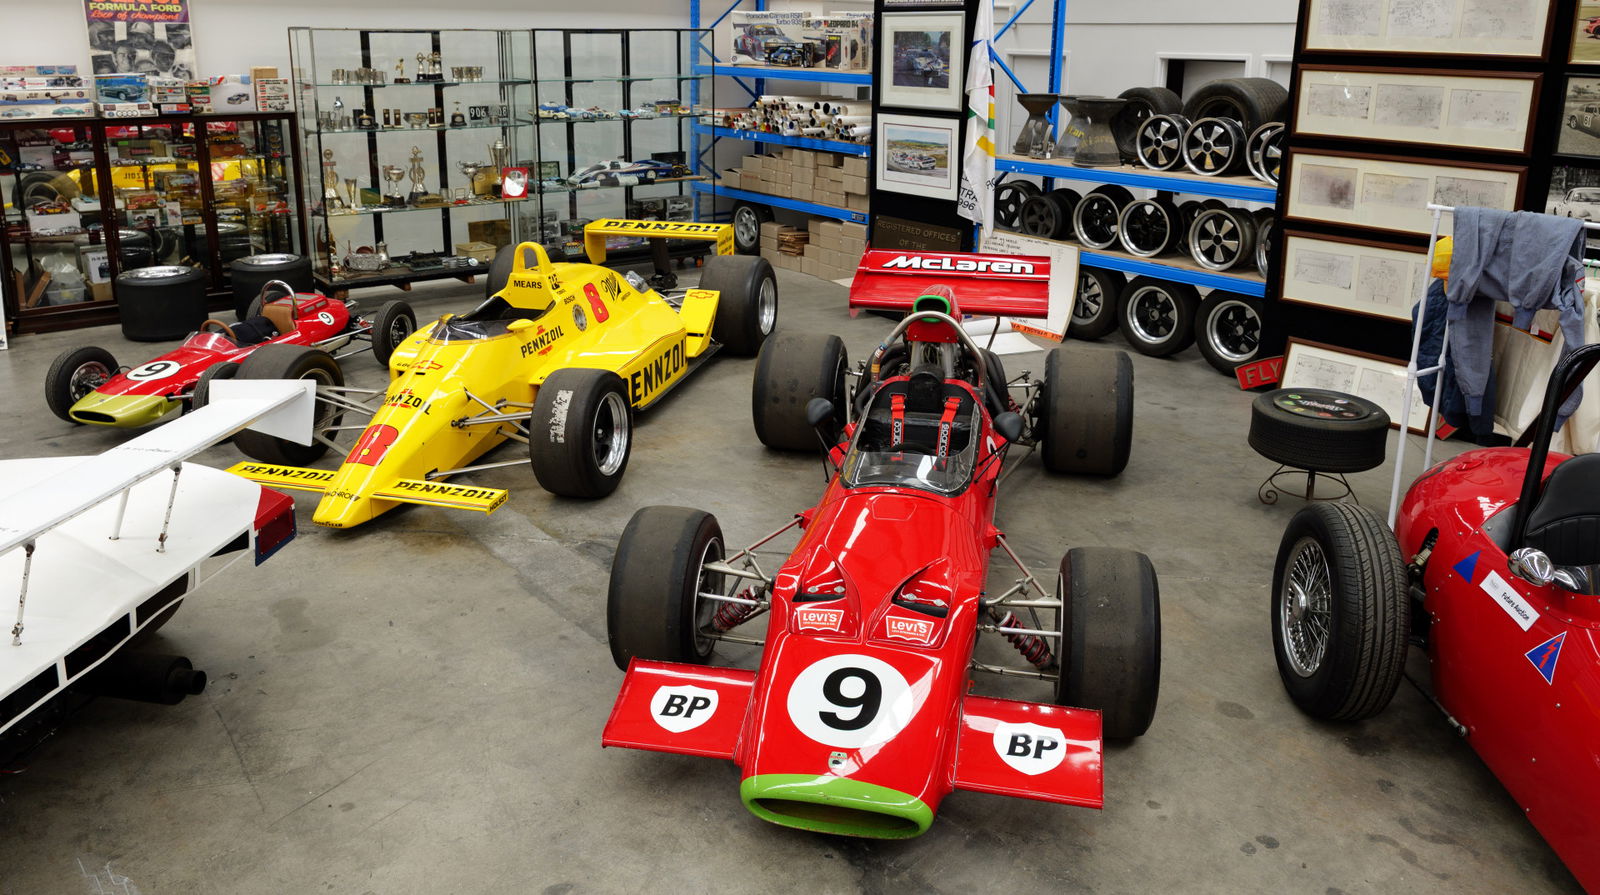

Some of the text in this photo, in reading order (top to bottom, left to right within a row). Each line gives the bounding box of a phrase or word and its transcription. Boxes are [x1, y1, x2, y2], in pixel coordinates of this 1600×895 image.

[89, 2, 147, 11] FORMULA
[151, 4, 182, 12] FORD
[116, 11, 128, 20] of
[470, 107, 487, 118] 906
[877, 221, 957, 242] REGISTERED OFFICES
[912, 242, 927, 250] THE
[882, 255, 1034, 274] McLaren
[513, 280, 542, 289] MEARS
[583, 282, 609, 323] 8
[320, 312, 332, 324] 9
[520, 325, 564, 358] PENNZOIL
[133, 362, 172, 377] 9
[621, 339, 685, 404] ENNZOI
[1245, 361, 1280, 385] FLY
[384, 393, 431, 415] ENNZOIL
[345, 424, 399, 466] 8
[239, 465, 336, 482] PENNZOIL
[393, 481, 499, 500] PENNZOIL
[1501, 592, 1529, 620] Future Auction
[659, 694, 711, 718] BP
[819, 667, 883, 731] 9
[1007, 732, 1059, 760] BP
